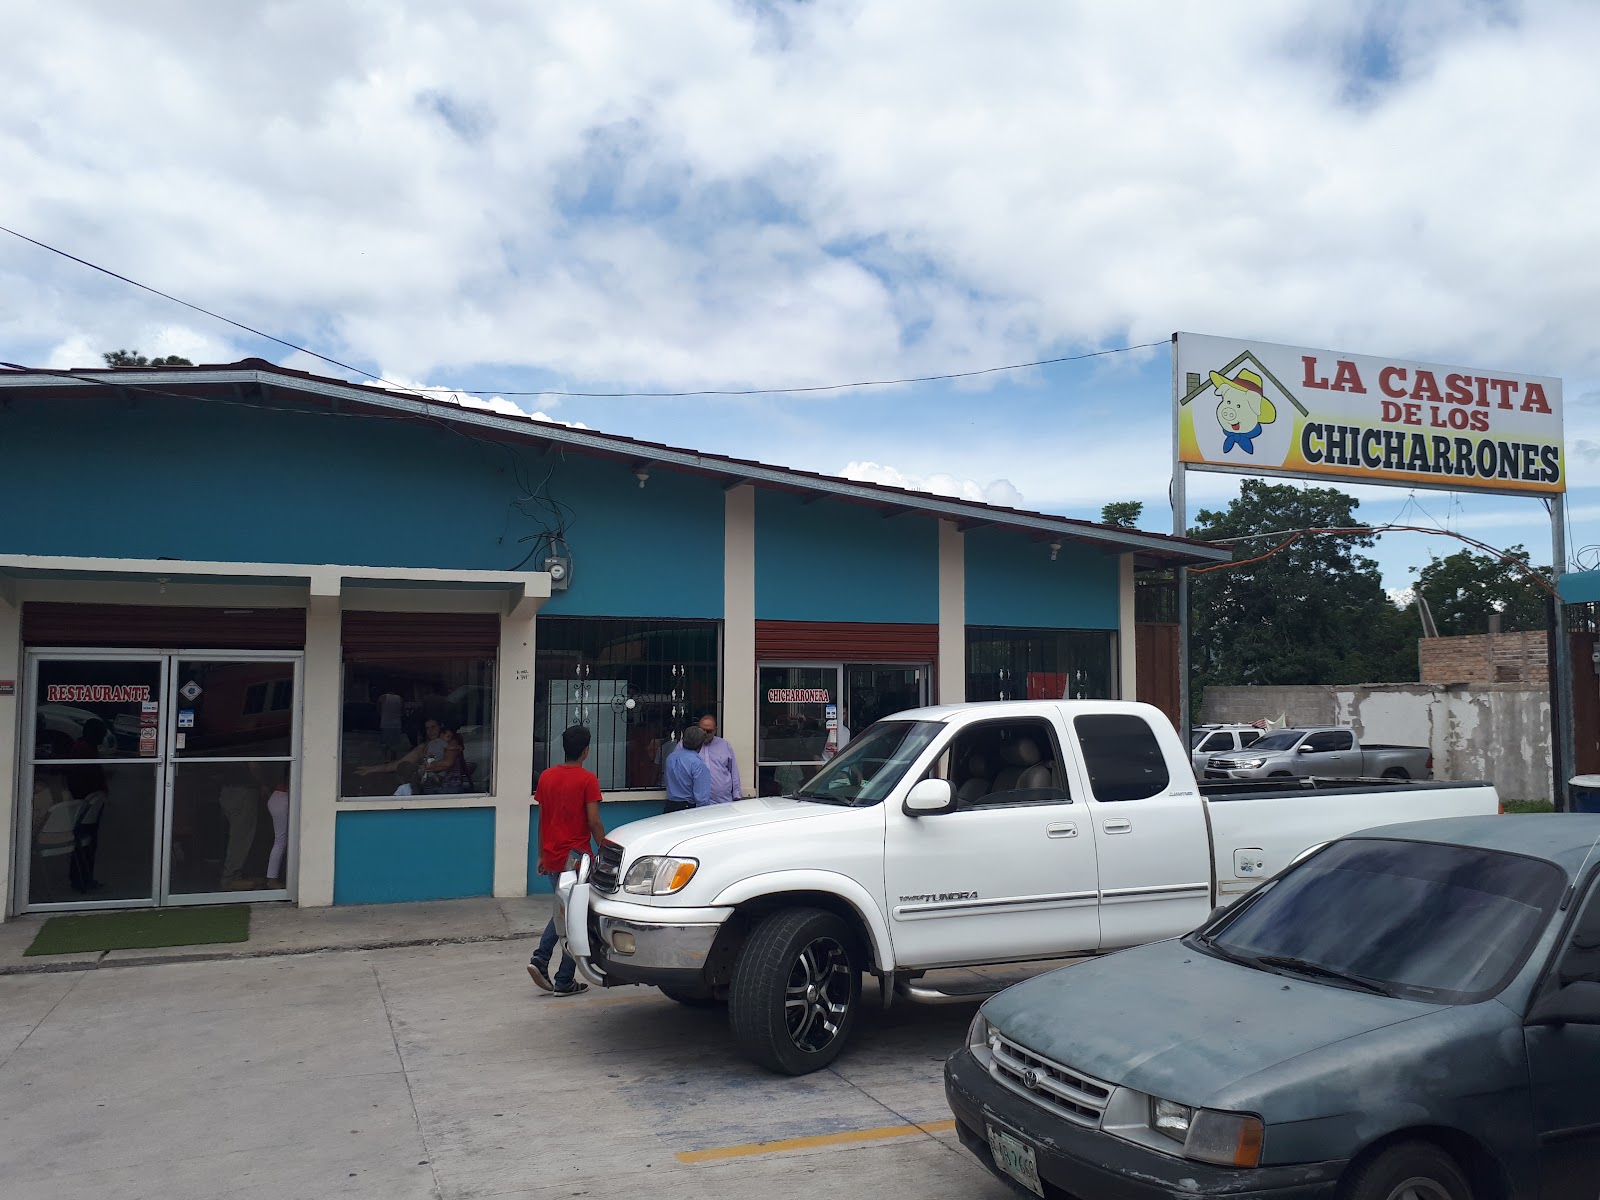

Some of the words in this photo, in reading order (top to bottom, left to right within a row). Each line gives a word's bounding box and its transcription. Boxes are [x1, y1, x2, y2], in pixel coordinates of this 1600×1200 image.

[1301, 355, 1367, 394] LA
[1378, 366, 1552, 414] CASITA
[1381, 400, 1422, 426] DE
[1430, 405, 1490, 432] LOS
[1301, 422, 1561, 484] CHICHARRONES
[48, 685, 150, 702] RESTAURANTE
[768, 689, 829, 703] CHICHARRONERA
[921, 890, 978, 902] TUNDRA
